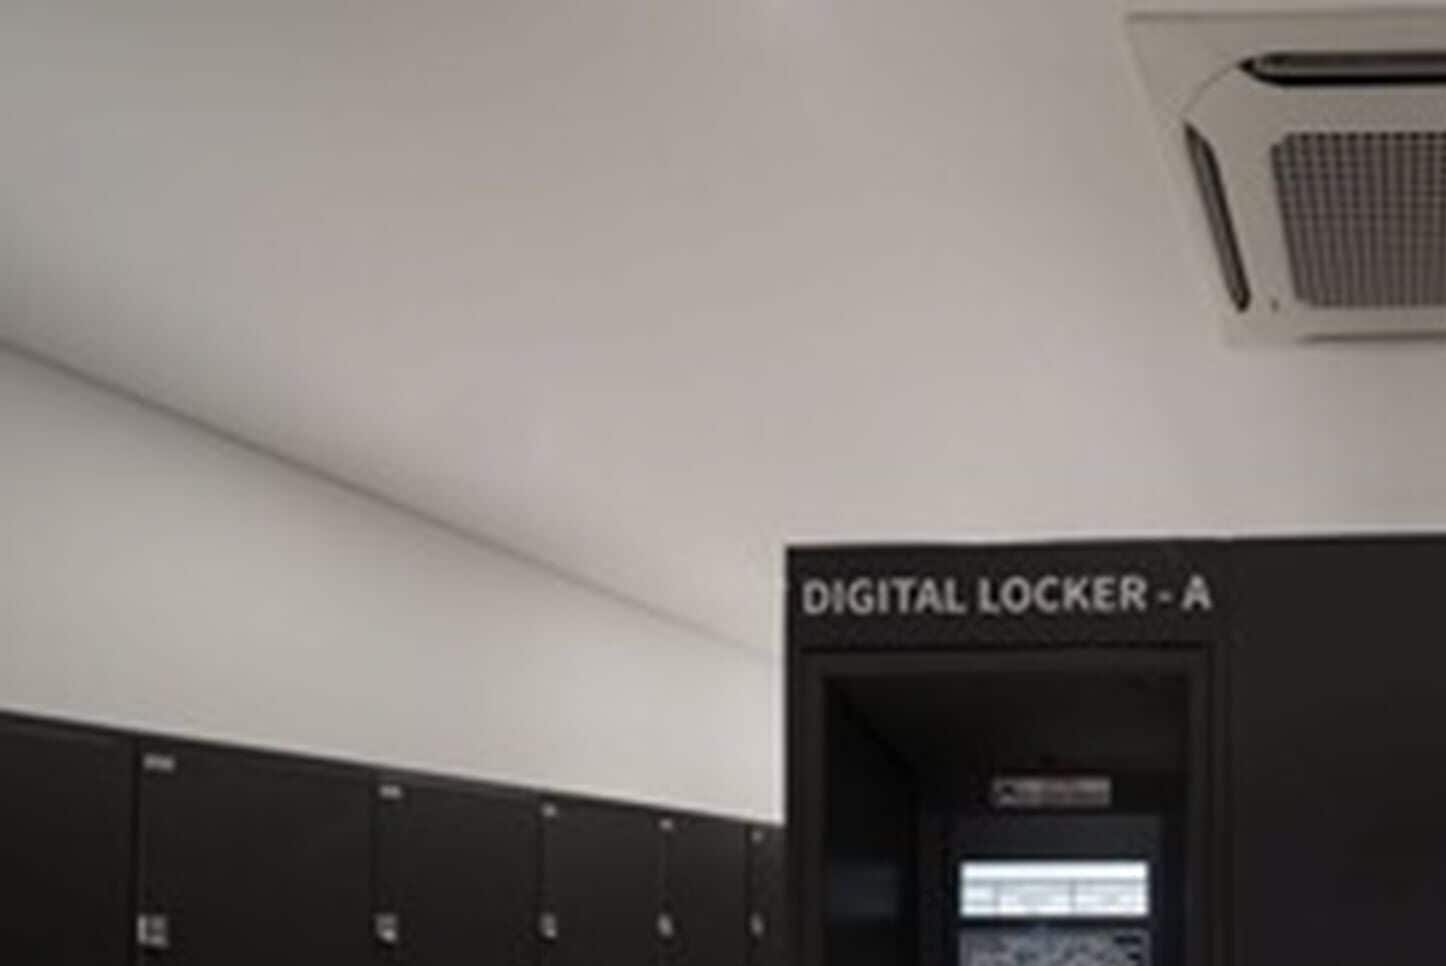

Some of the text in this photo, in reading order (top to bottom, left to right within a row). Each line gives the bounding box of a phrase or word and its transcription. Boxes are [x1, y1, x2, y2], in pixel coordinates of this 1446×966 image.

[803, 578, 968, 615] DIGITAL
[978, 574, 1148, 614] LOCKER
[1181, 574, 1213, 610] A
